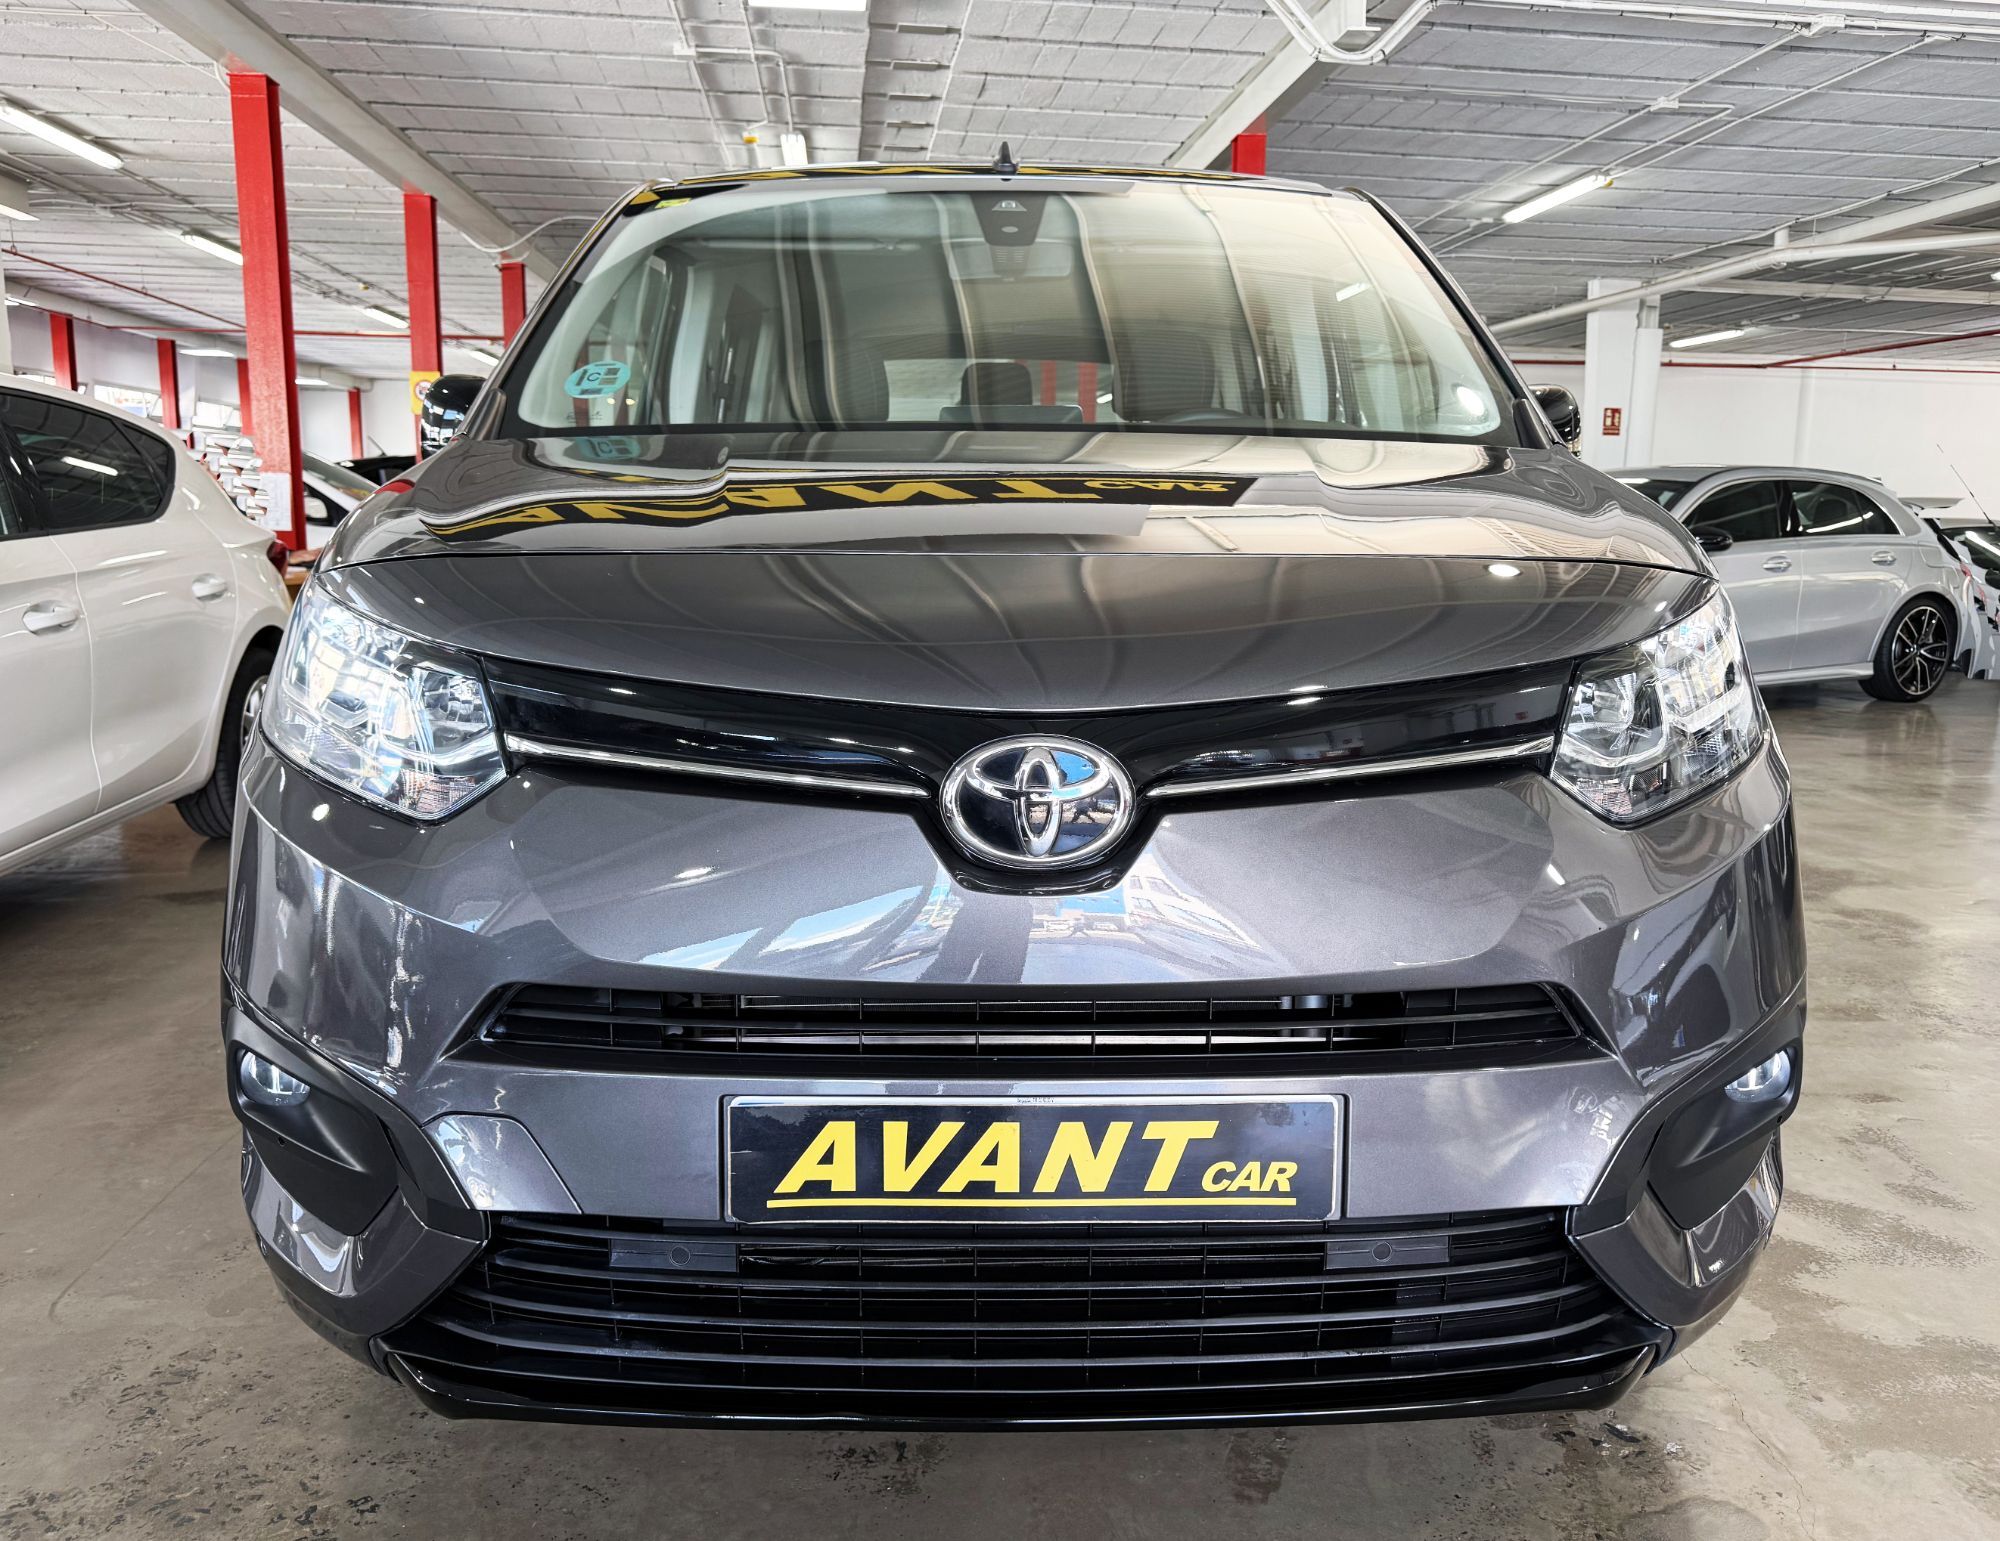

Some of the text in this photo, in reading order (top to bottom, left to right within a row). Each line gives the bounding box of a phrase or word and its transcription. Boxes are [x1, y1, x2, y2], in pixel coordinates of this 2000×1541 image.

[587, 372, 602, 382] C
[773, 1120, 1298, 1193] AVANT CAR
